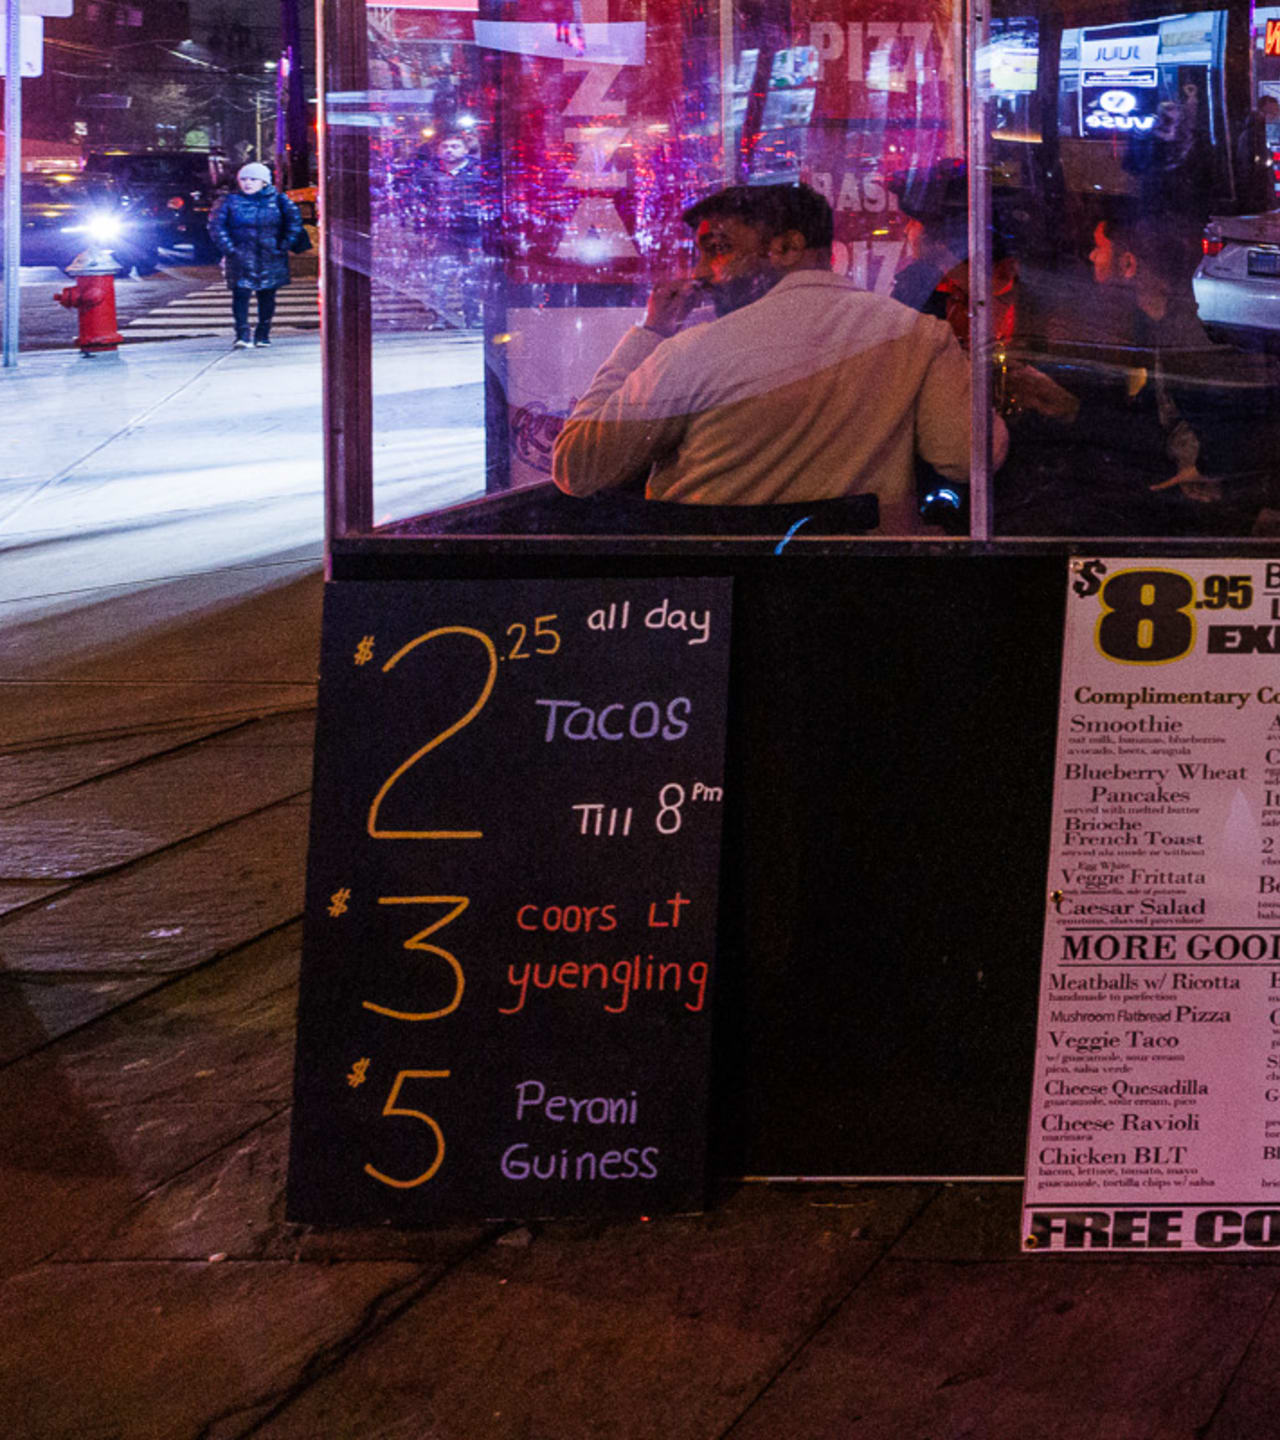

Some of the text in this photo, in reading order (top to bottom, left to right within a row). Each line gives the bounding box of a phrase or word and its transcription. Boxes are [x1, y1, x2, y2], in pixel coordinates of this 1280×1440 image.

[586, 600, 630, 631] all
[644, 598, 711, 646] day
[1074, 686, 1251, 709] Complimentary
[1070, 715, 1183, 734] Smoothie
[1065, 763, 1249, 785] Blueberry Wheat
[1091, 787, 1191, 804] Pancakes
[1065, 817, 1142, 831] Brioche
[1064, 831, 1204, 846] French Toast
[1261, 837, 1274, 854] 2
[1062, 869, 1125, 890] Veggie
[1130, 869, 1206, 885] Frittata
[1055, 898, 1206, 916] Caesar Salad
[516, 903, 618, 933] coors
[1061, 934, 1177, 961] MORE
[498, 955, 709, 1014] yuengling
[1048, 973, 1241, 990] Meatballs w/ Ricotta
[1051, 1005, 1232, 1023] Mushroom Flatbread Pizza
[1048, 1031, 1180, 1053] Veggie Taco
[1044, 1079, 1209, 1098] Cheese Quesadilla
[514, 1080, 638, 1124] Peroni
[1041, 1113, 1200, 1132] Cheese Ravioli
[500, 1143, 659, 1181] Guiness
[1039, 1146, 1188, 1165] Chicken BLT
[1030, 1211, 1184, 1249] FREE
